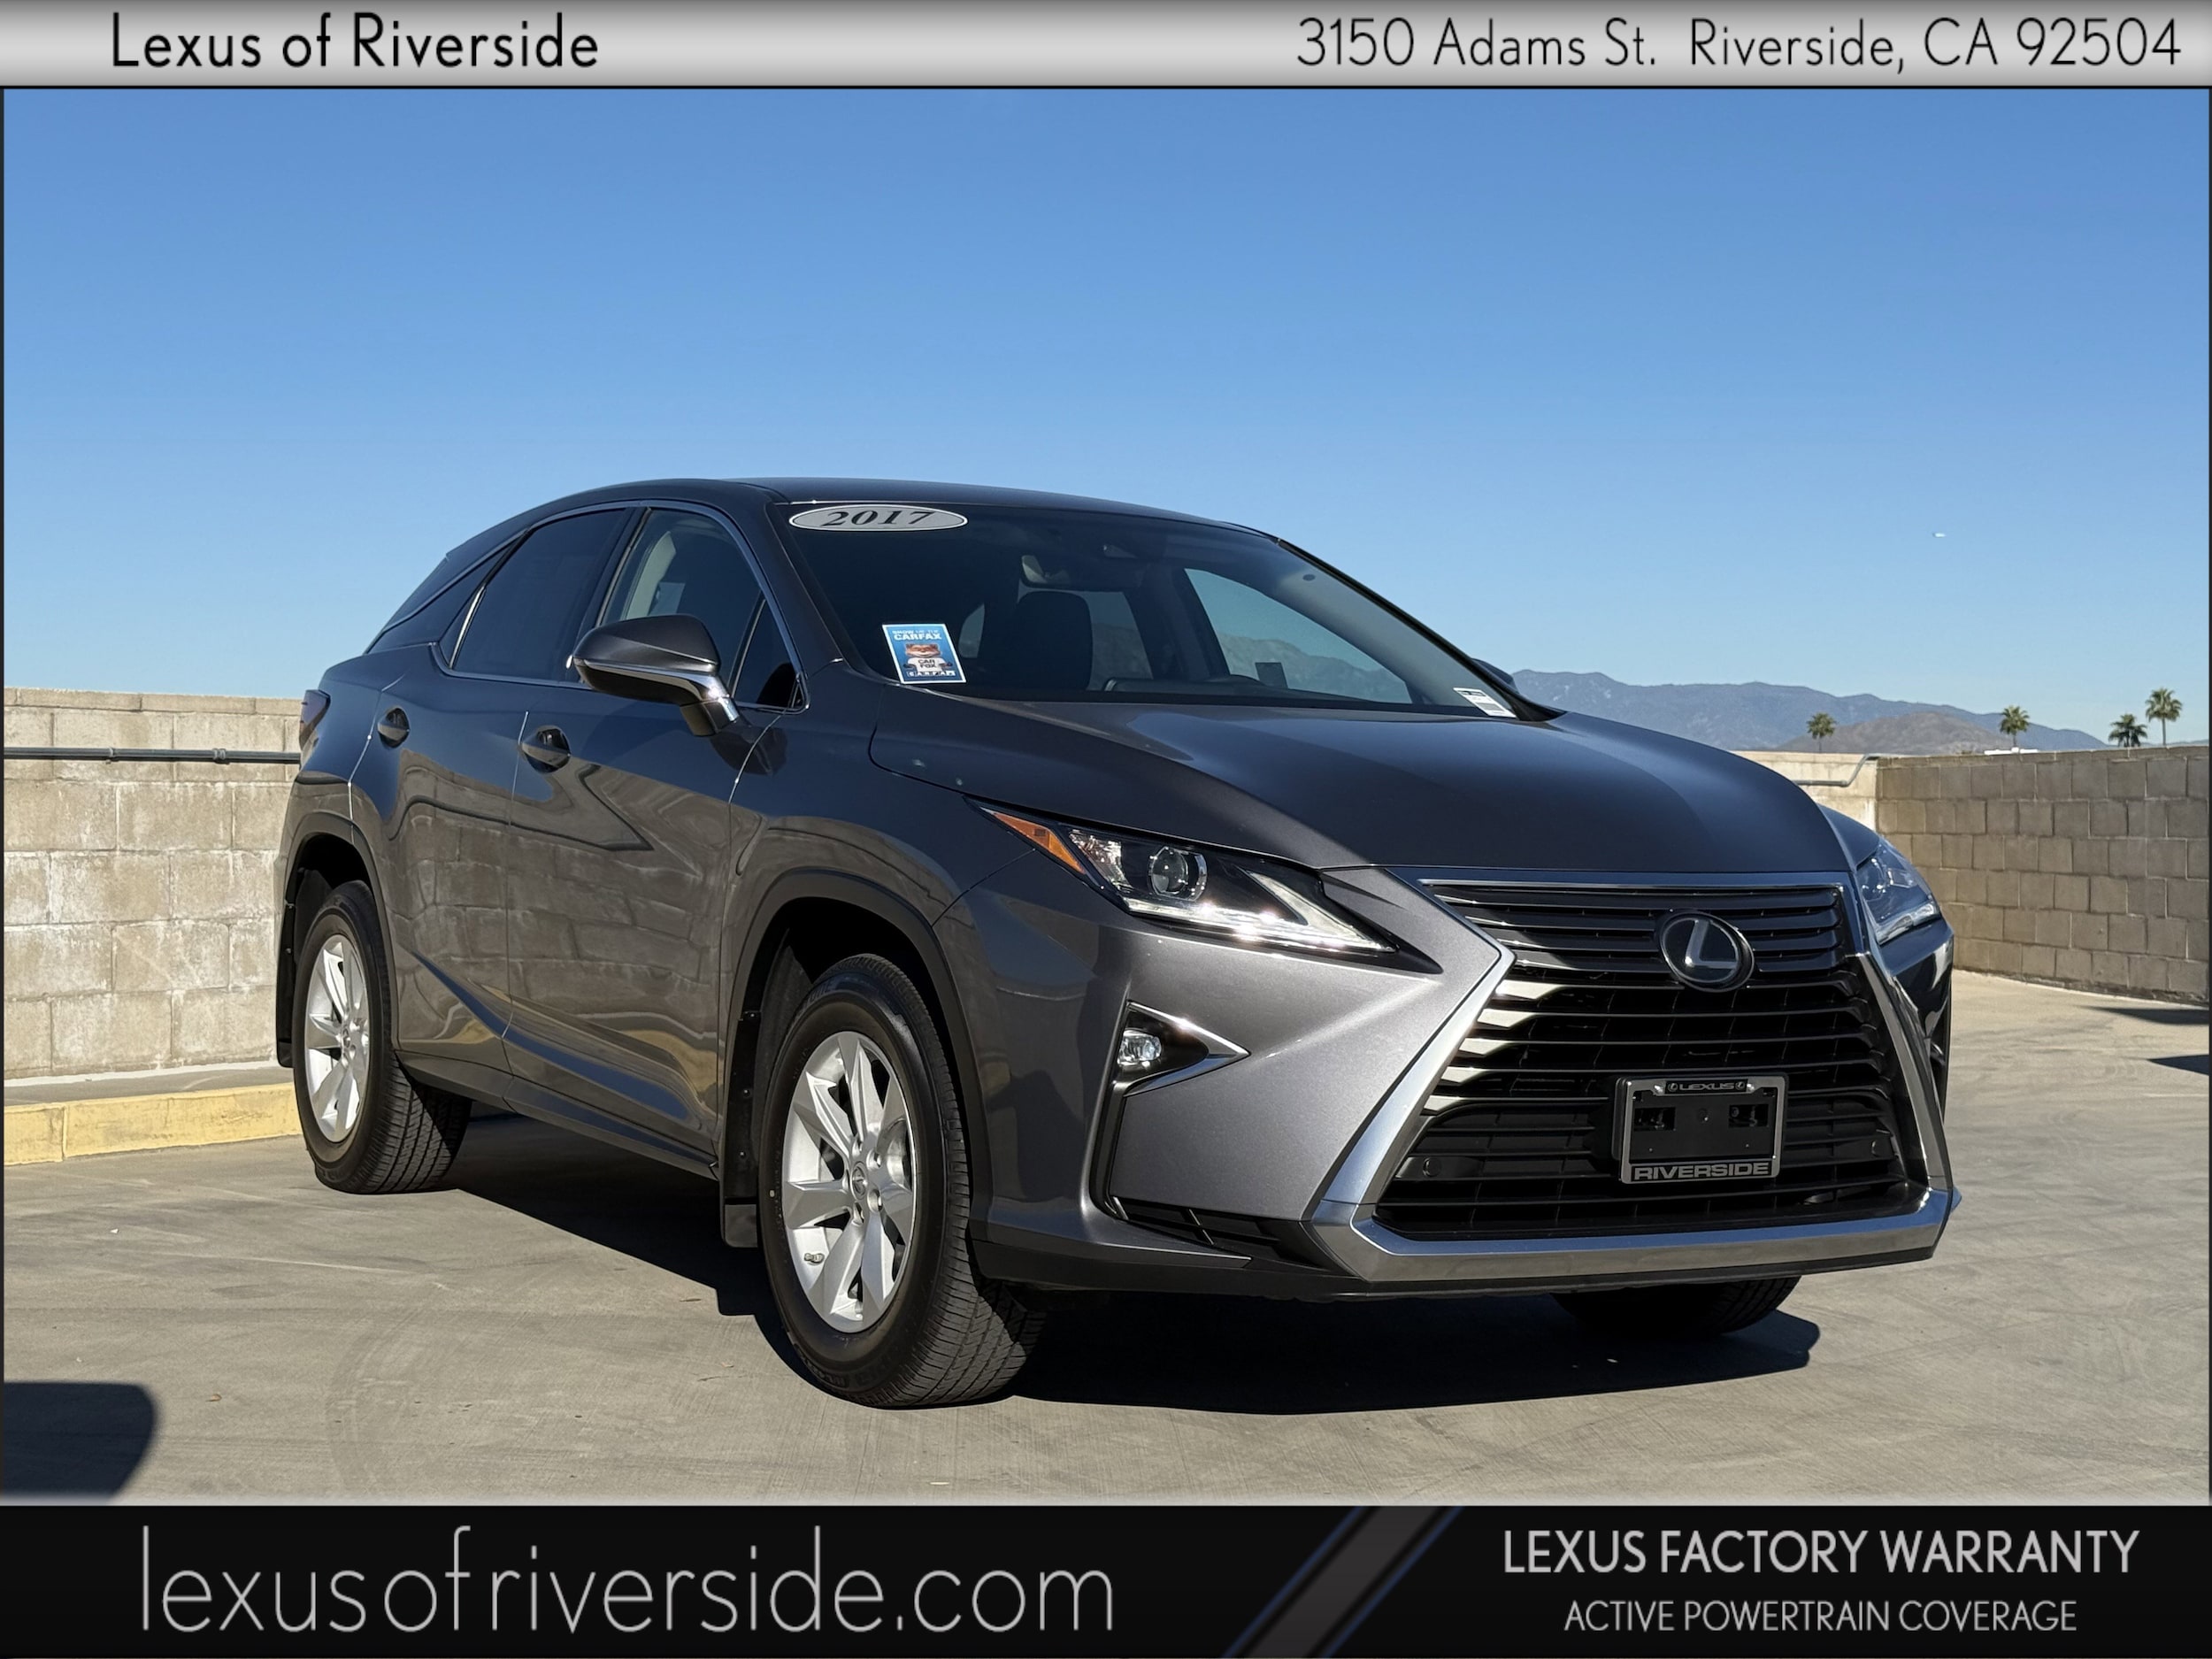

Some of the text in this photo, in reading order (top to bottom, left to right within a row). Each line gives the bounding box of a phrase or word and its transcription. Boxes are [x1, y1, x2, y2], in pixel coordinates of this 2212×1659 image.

[821, 510, 935, 527] 2017
[1678, 1082, 1735, 1091] LEXUS
[1633, 1162, 1770, 1180] RIVERSIDE
